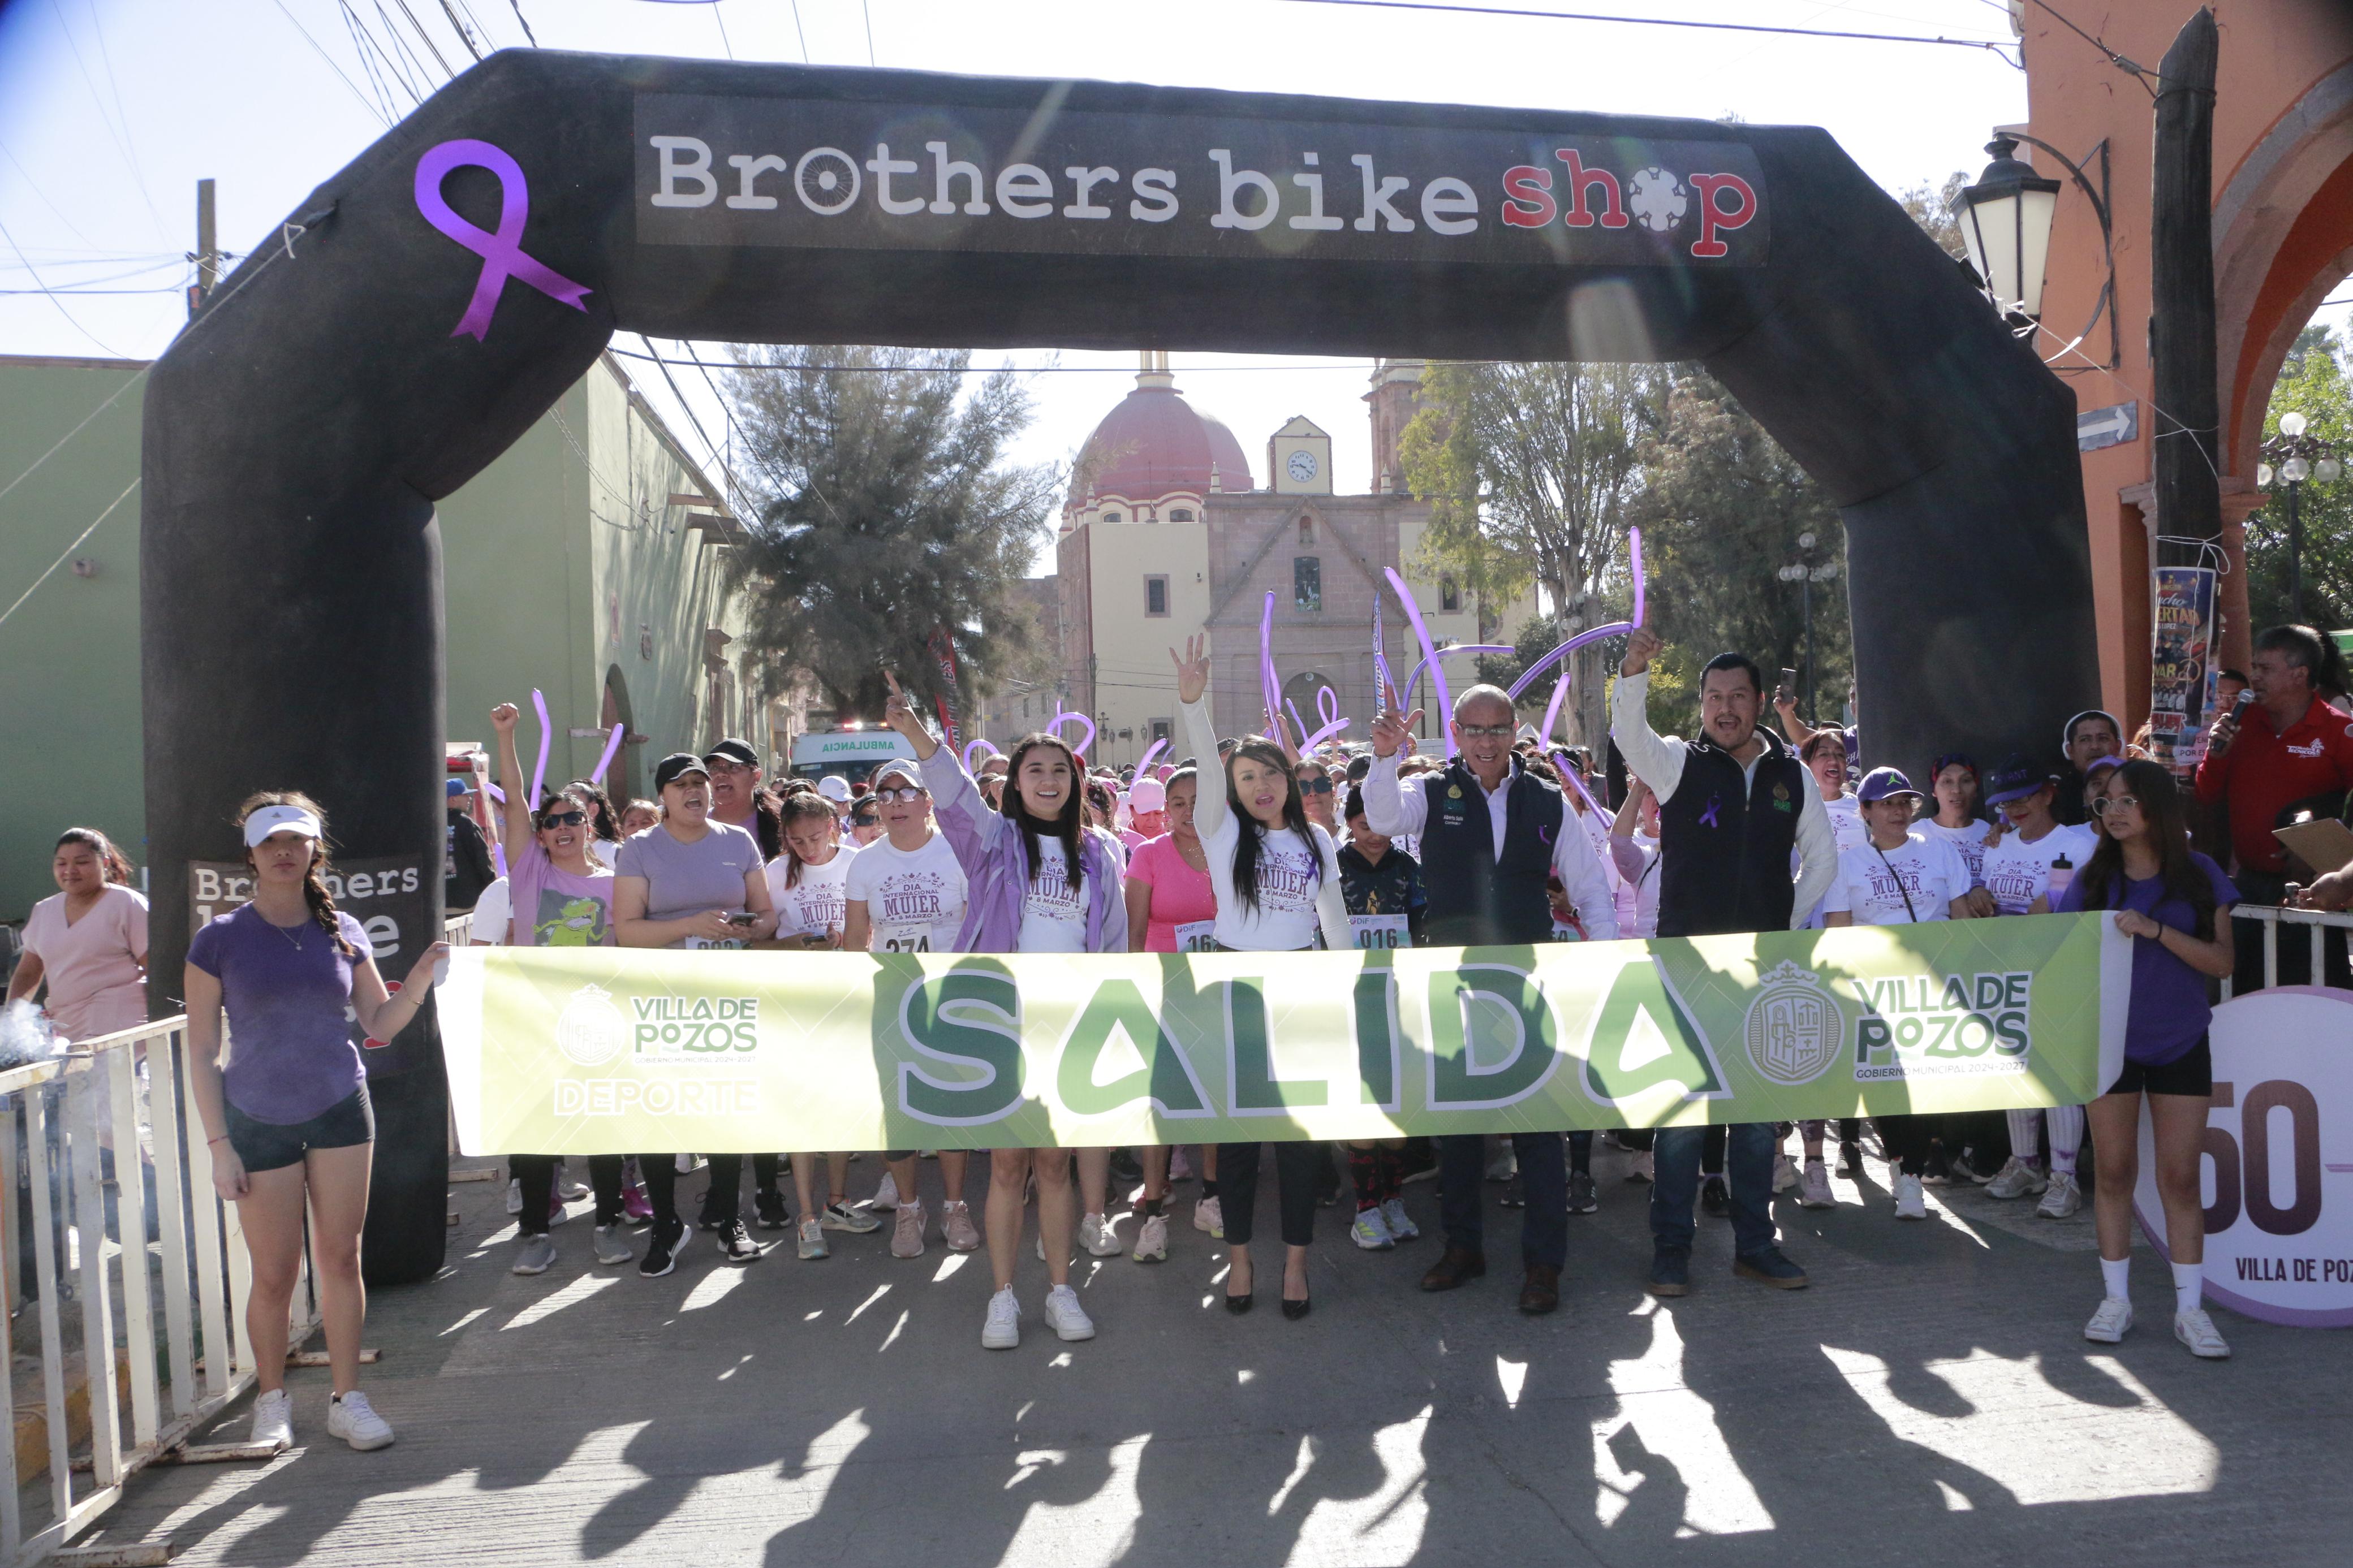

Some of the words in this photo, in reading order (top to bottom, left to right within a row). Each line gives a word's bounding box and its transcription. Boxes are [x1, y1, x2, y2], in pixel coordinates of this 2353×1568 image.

[650, 136, 1179, 222] Brothers
[1209, 149, 1479, 235] bike
[1501, 148, 1757, 257] shop
[195, 867, 419, 901] Brhers
[883, 889, 940, 899] INTERNACIONAL
[1255, 867, 1308, 896] MUJER
[1989, 878, 2035, 898] MUJER
[884, 895, 941, 917] MUJER
[1043, 898, 1070, 908] MARZO
[1272, 891, 1298, 899] MARZO
[1360, 928, 1398, 949] 016
[1852, 977, 1971, 1015] VILLA
[1976, 974, 2029, 1010] DE
[633, 999, 714, 1021] VILLA
[718, 999, 757, 1020] DE
[635, 1022, 757, 1053] POZOS
[899, 954, 1734, 1126] SALIDA
[1856, 1011, 2028, 1063] POZOS
[1856, 1067, 1911, 1078] GOBIERNO
[1912, 1065, 1967, 1075] MUNICIPAL
[1968, 1061, 2025, 1072] 2024-2027
[555, 1079, 759, 1115] DEPORTE
[2235, 1257, 2287, 1281] VILLA
[2293, 1258, 2317, 1282] DE
